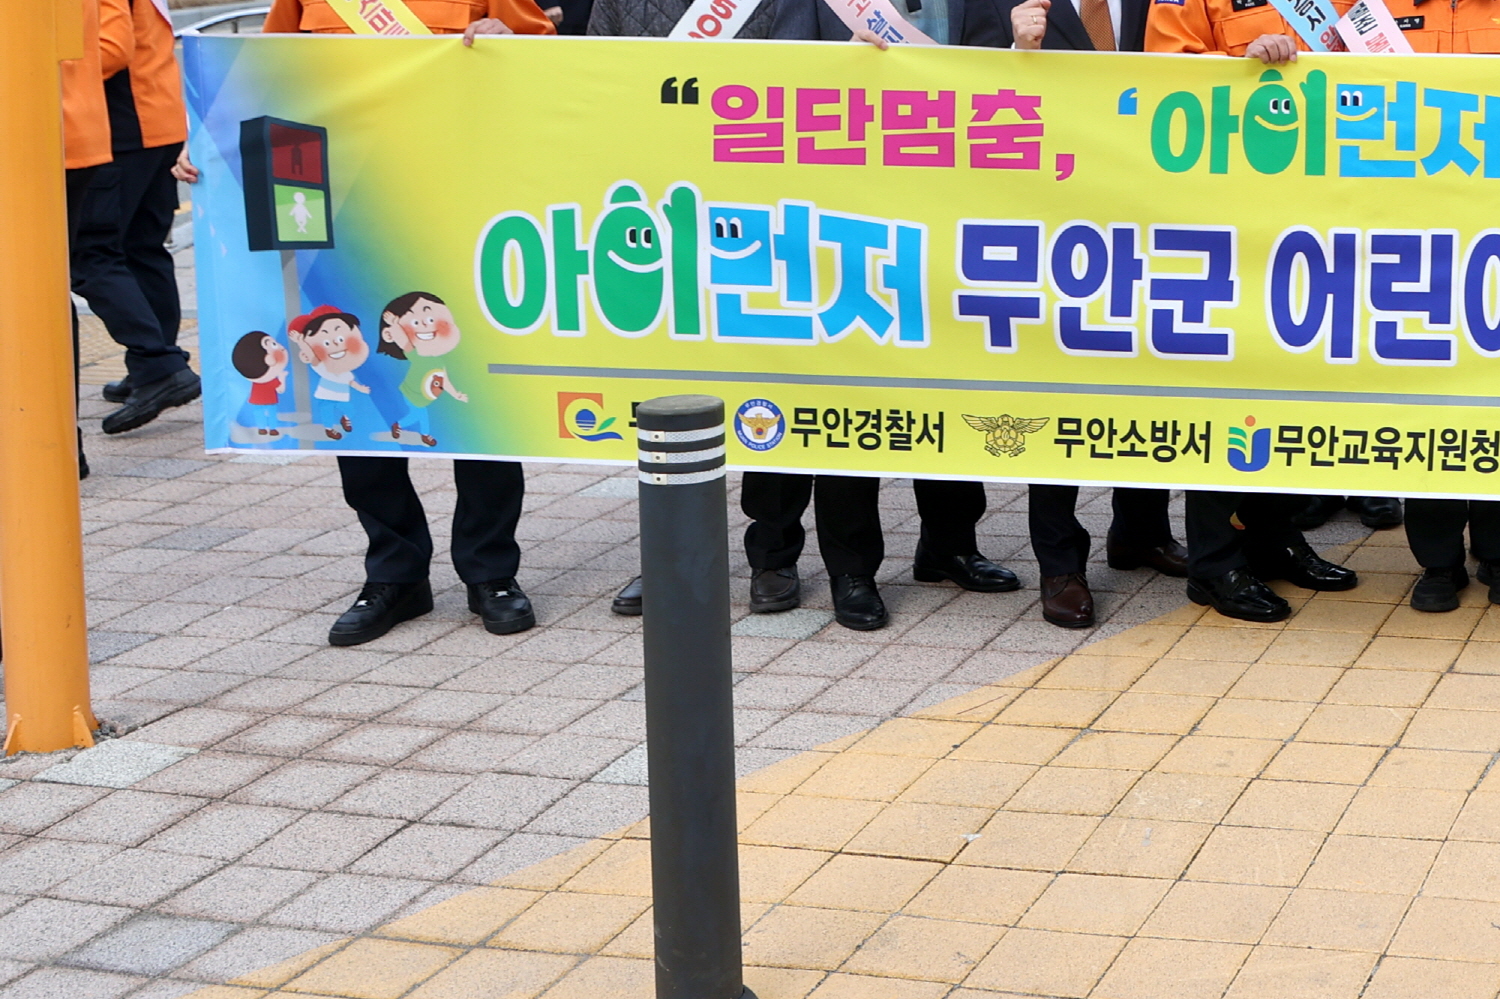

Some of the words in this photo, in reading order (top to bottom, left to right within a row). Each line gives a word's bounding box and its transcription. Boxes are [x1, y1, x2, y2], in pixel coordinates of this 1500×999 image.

[480, 184, 925, 344] 아이먼저
[957, 222, 1235, 355] 무안군
[790, 407, 945, 453] 무안경찰서
[1053, 417, 1212, 464] 무안소방서
[1274, 424, 1500, 474] 무안교육지원청
